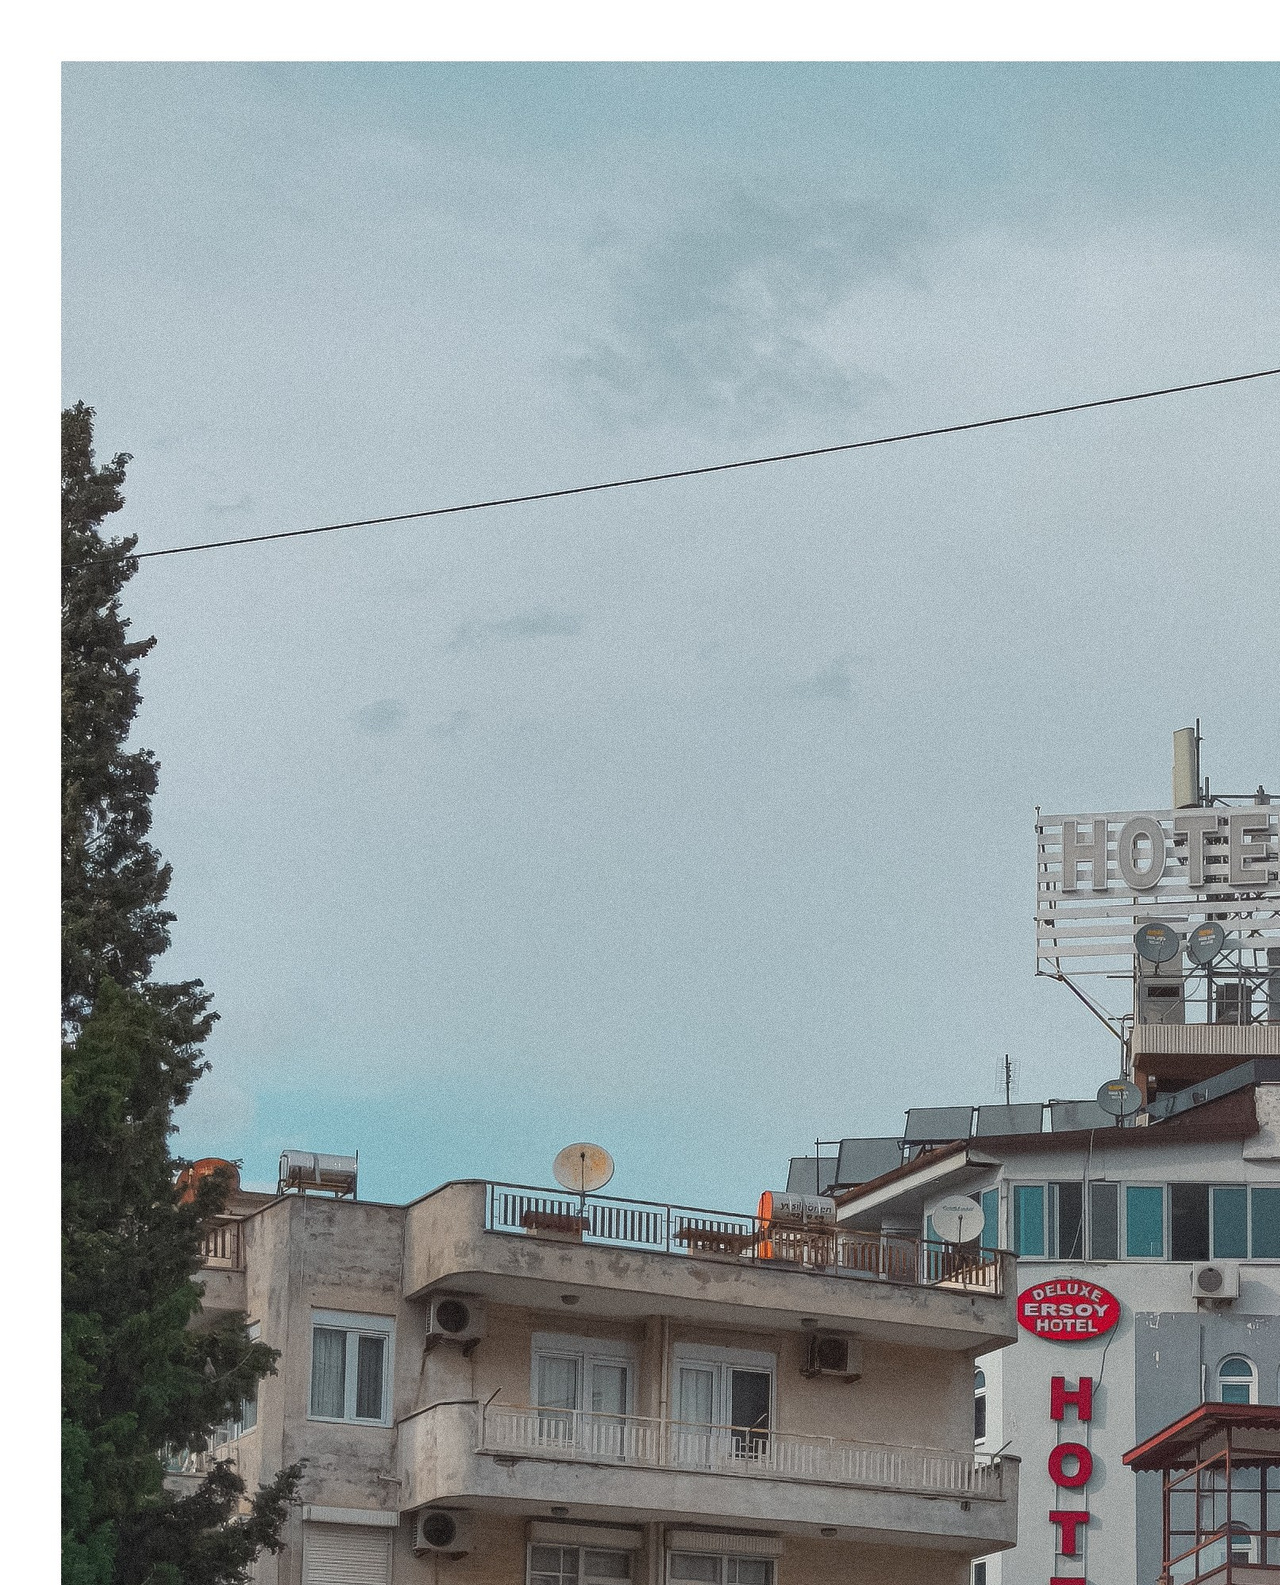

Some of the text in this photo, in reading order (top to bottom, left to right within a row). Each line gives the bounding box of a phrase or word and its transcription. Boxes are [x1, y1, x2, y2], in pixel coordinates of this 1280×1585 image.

[1032, 1283, 1103, 1302] DELUXE
[1024, 1303, 1109, 1317] ERSOY
[1036, 1319, 1098, 1332] HOTEL
